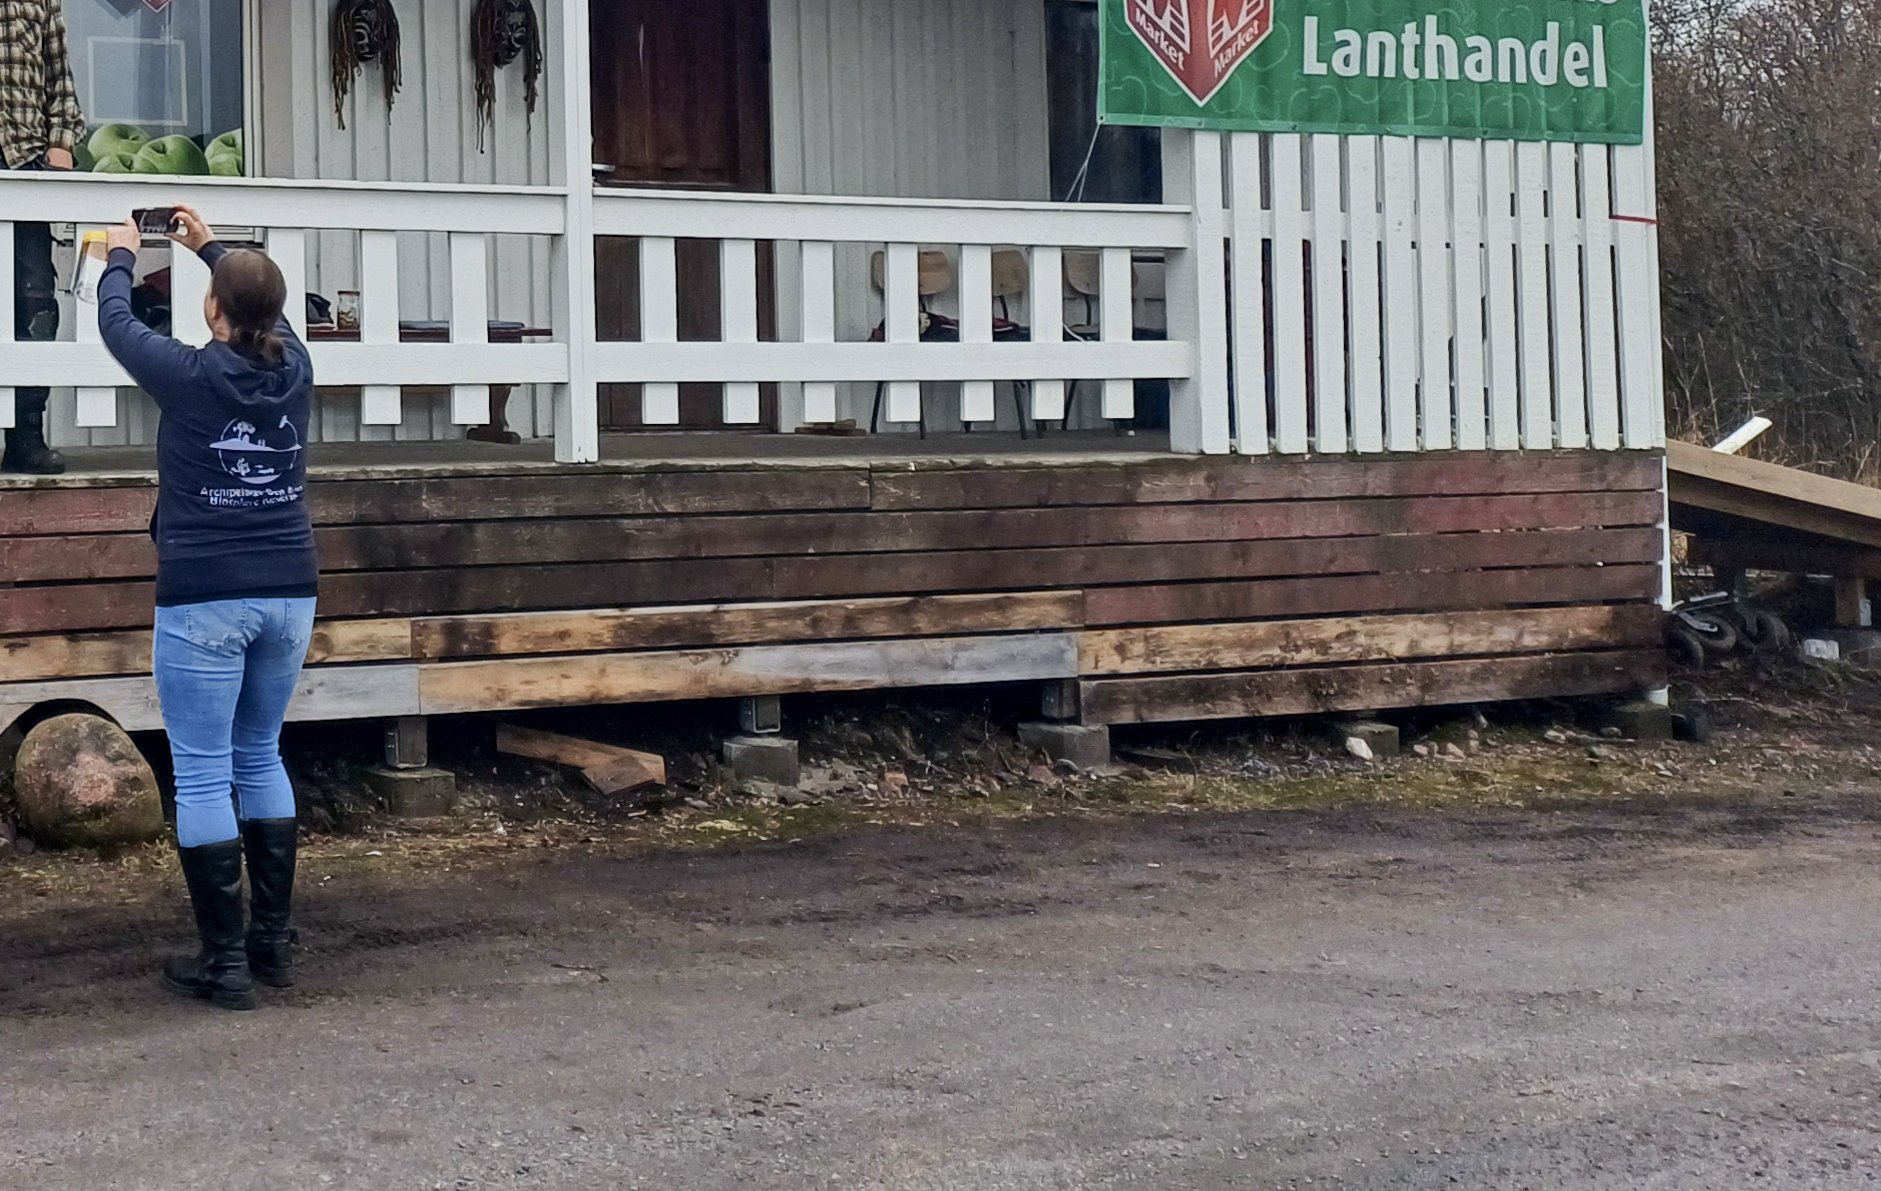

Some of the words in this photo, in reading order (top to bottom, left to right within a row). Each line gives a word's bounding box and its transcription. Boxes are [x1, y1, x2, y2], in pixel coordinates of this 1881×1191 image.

[1135, 7, 1185, 72] Market
[1214, 18, 1261, 79] Market
[1302, 14, 1609, 89] Lanthandel
